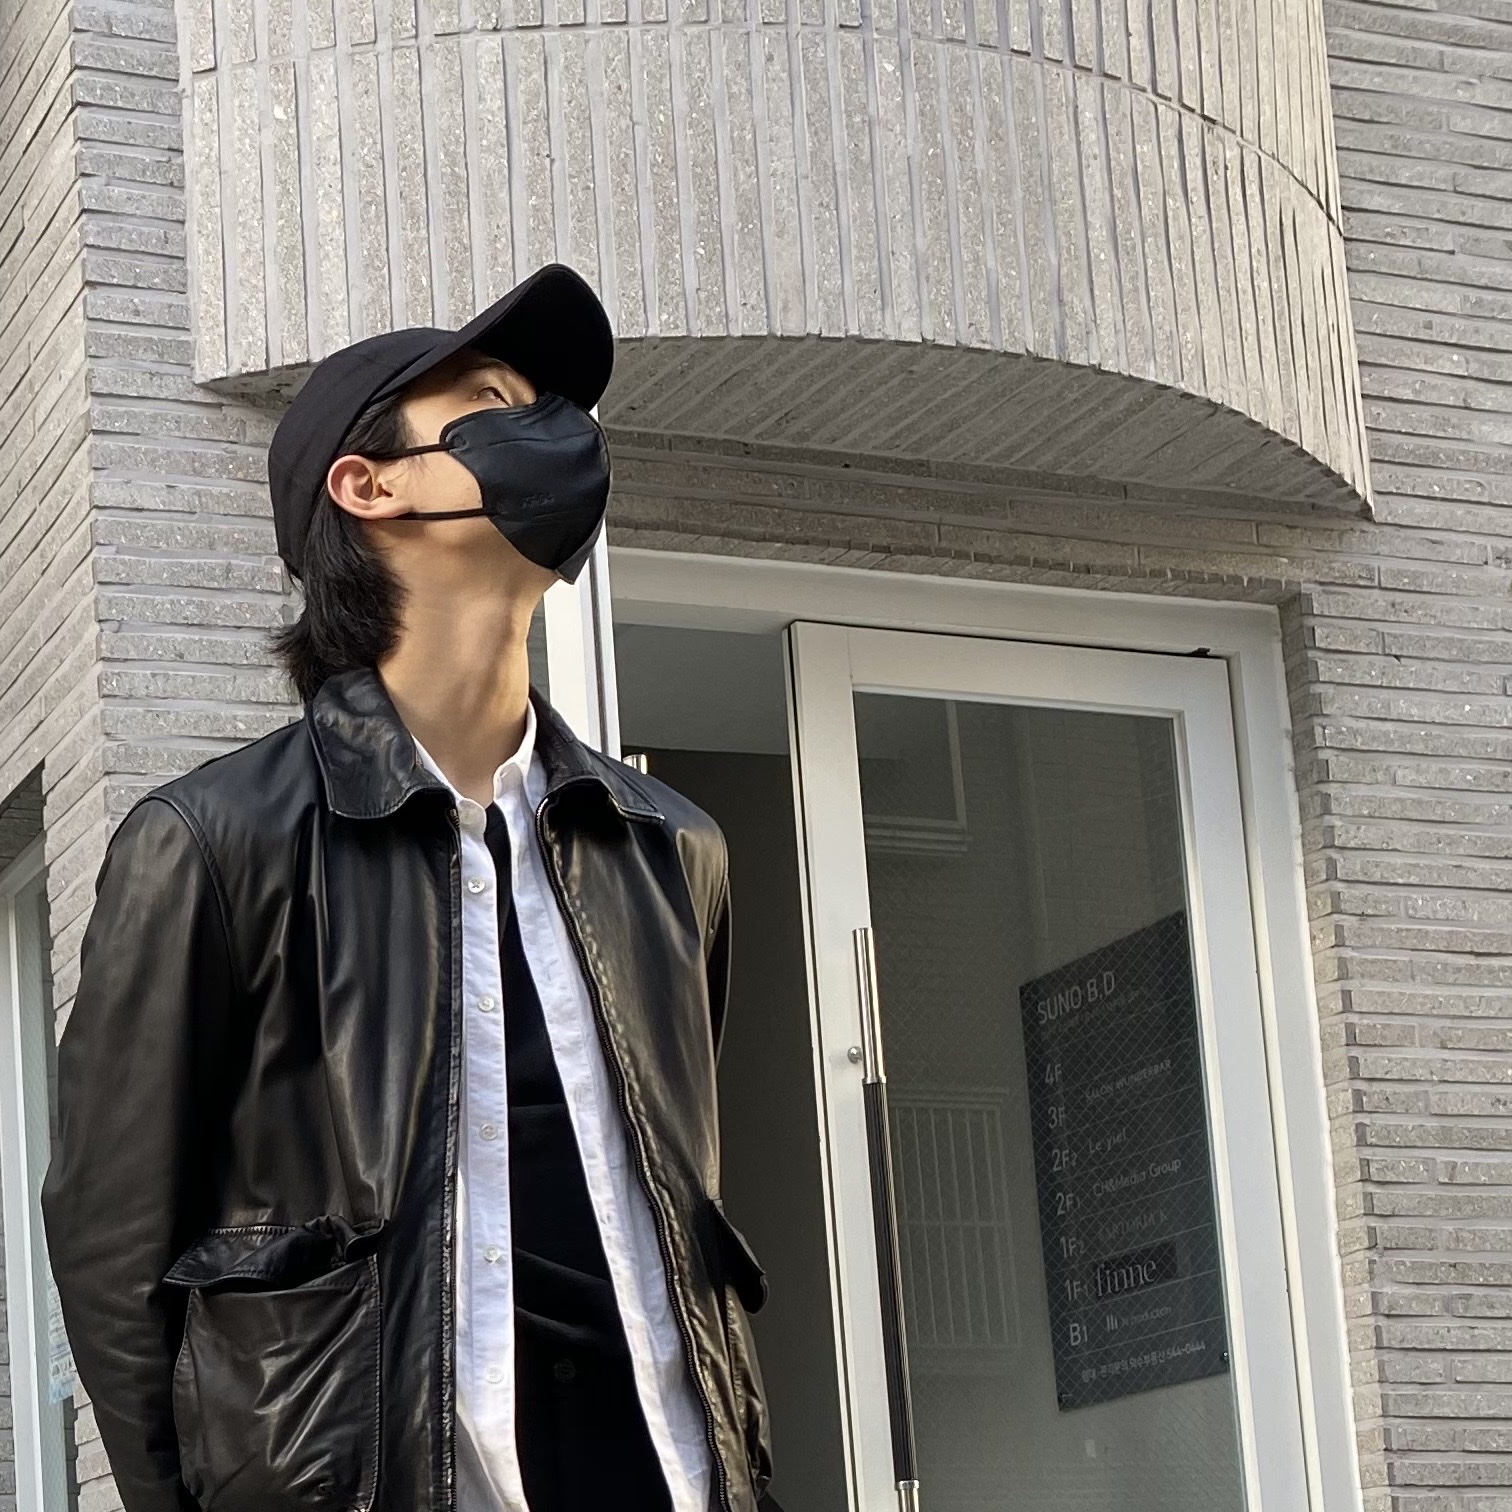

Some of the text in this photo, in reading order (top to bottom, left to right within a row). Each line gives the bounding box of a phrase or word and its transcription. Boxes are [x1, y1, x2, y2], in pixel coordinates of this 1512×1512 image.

[1037, 985, 1083, 1025] SUNO
[1044, 1063, 1063, 1085] 4F
[1047, 1105, 1066, 1129] 3F
[1149, 1158, 1182, 1178] Group
[1096, 1259, 1157, 1297] finne
[1069, 1322, 1088, 1346] B1
